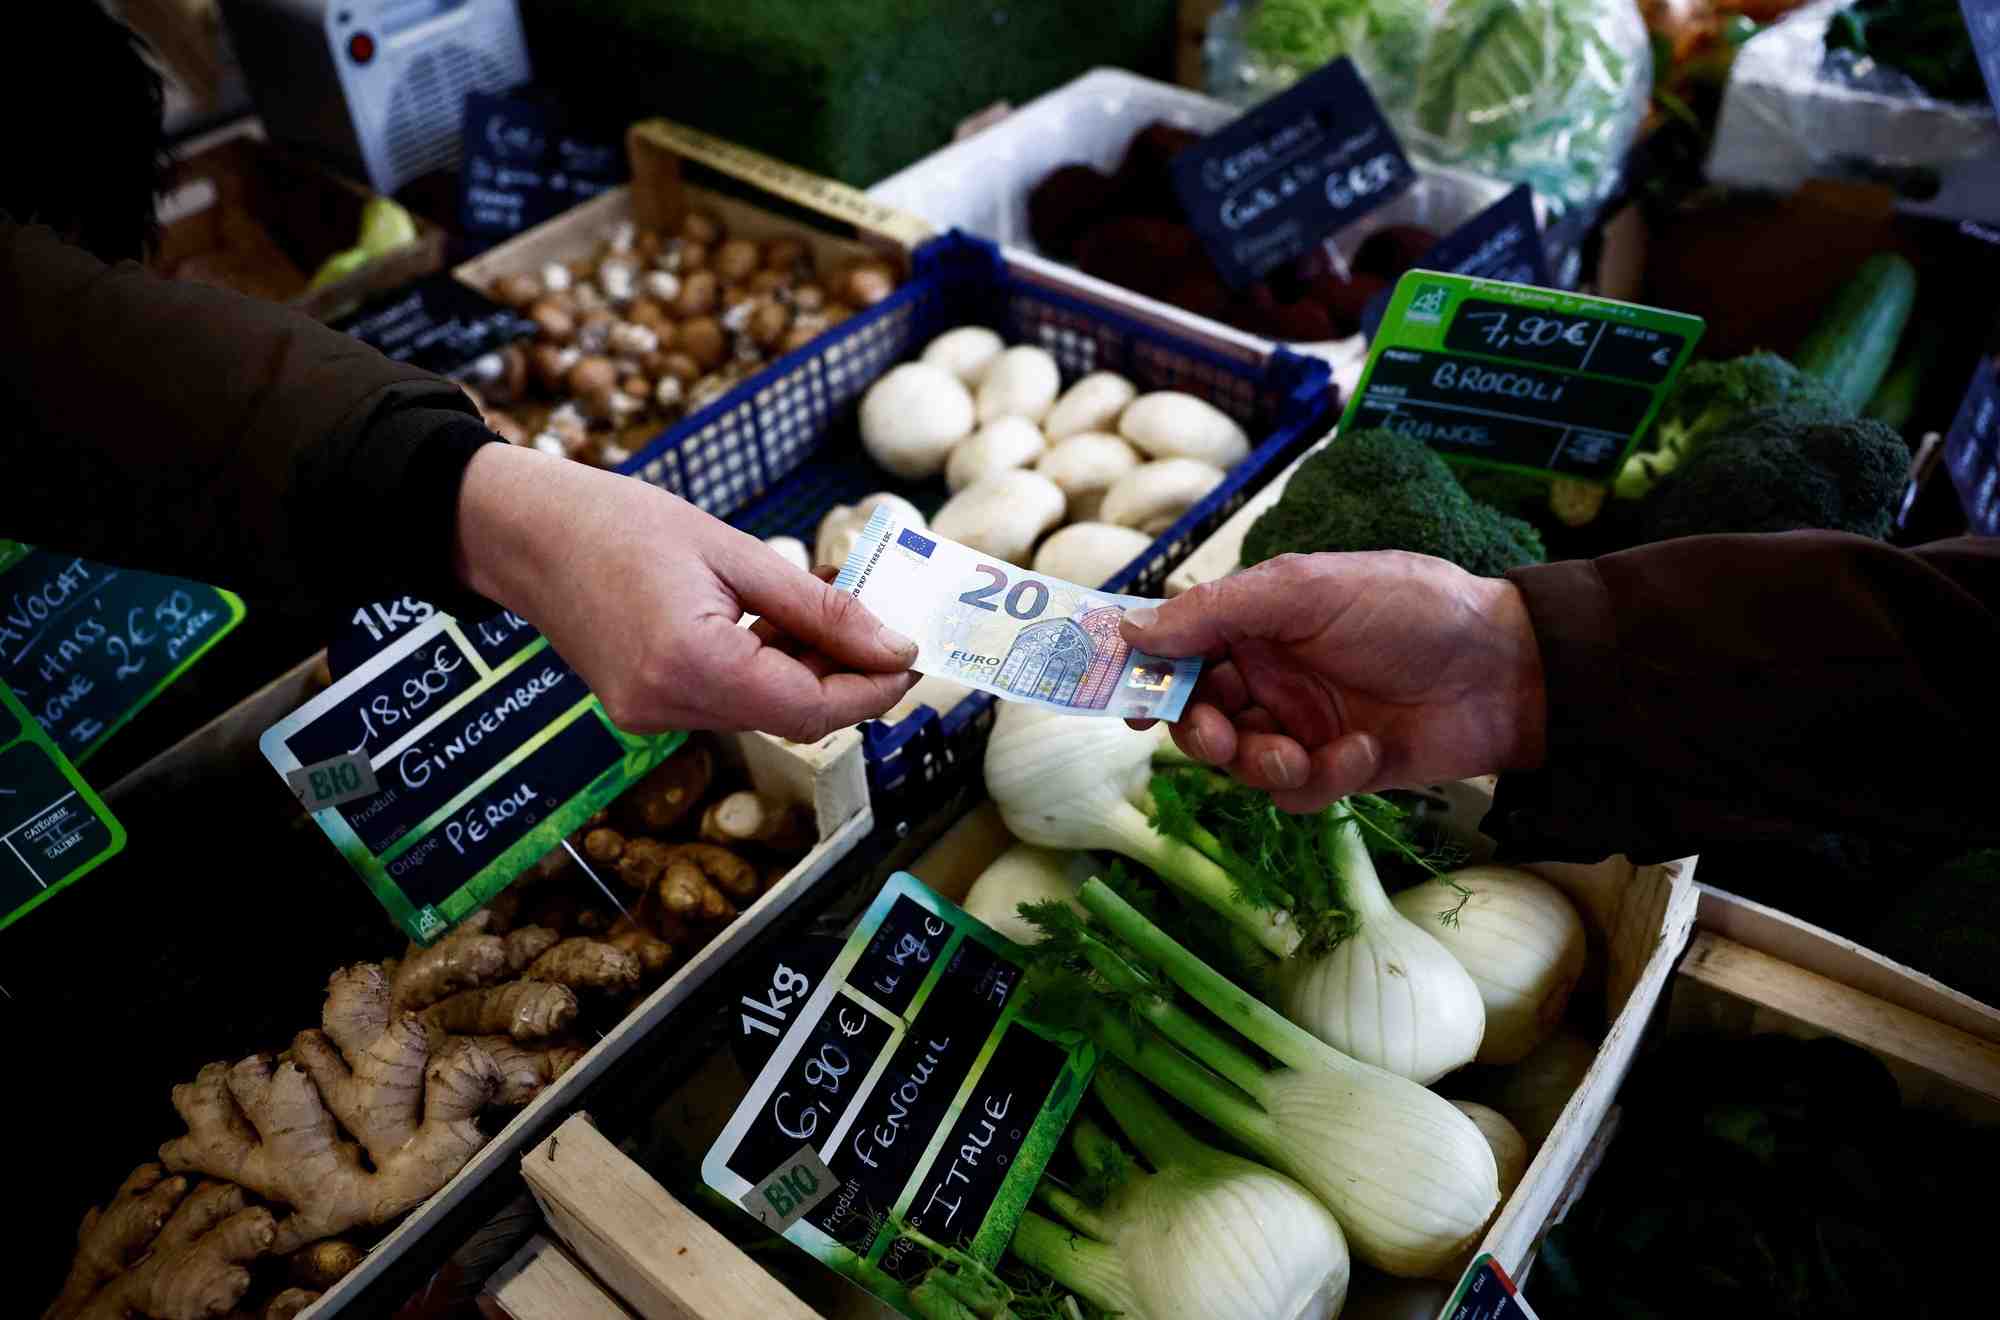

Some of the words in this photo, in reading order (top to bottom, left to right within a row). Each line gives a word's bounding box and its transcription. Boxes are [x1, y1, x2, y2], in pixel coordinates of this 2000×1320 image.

[1466, 308, 1591, 348] 7,90€
[959, 564, 1049, 620] 20
[352, 596, 434, 641] 1kg
[950, 650, 1000, 666] EURO
[347, 645, 462, 754] 18,90€
[310, 762, 360, 800] BIO
[390, 838, 439, 876] Origine
[741, 963, 809, 1038] 1kg
[774, 1043, 849, 1140] 6,90
[924, 916, 945, 936] €
[763, 1165, 818, 1217] BIO
[822, 1175, 861, 1232] Produit
